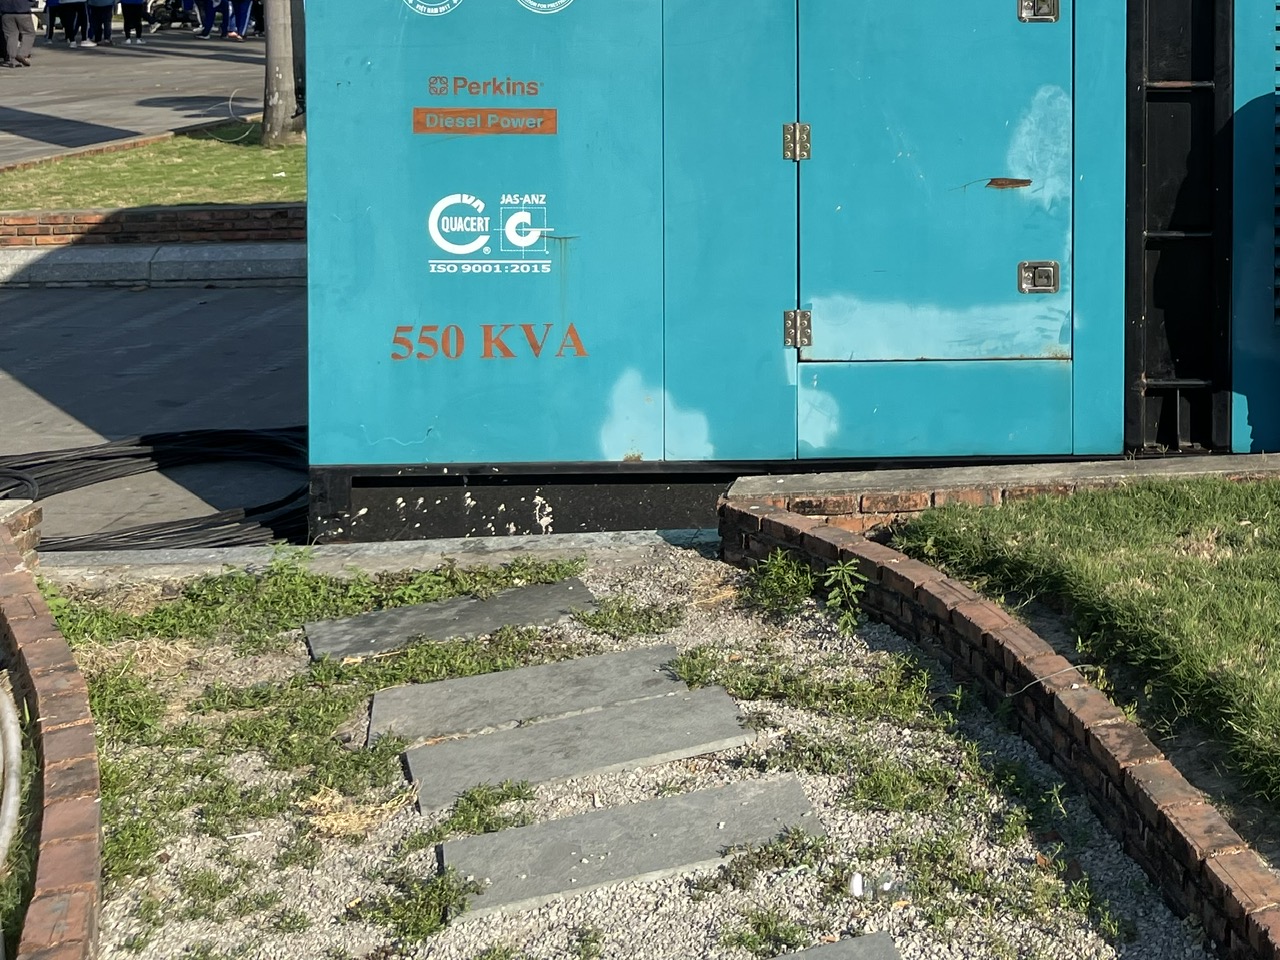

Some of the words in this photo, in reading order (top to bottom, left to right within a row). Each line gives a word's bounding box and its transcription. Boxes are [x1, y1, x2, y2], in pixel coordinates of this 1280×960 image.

[453, 76, 539, 96] Perkins
[426, 113, 481, 128] Diesel
[487, 114, 544, 129] Power
[500, 193, 546, 205] JAS-ANZ
[441, 216, 490, 232] QUACERT
[429, 264, 458, 273] ISO
[461, 264, 551, 273] 9001:2015
[391, 324, 465, 360] 550
[480, 322, 589, 358] KVA
